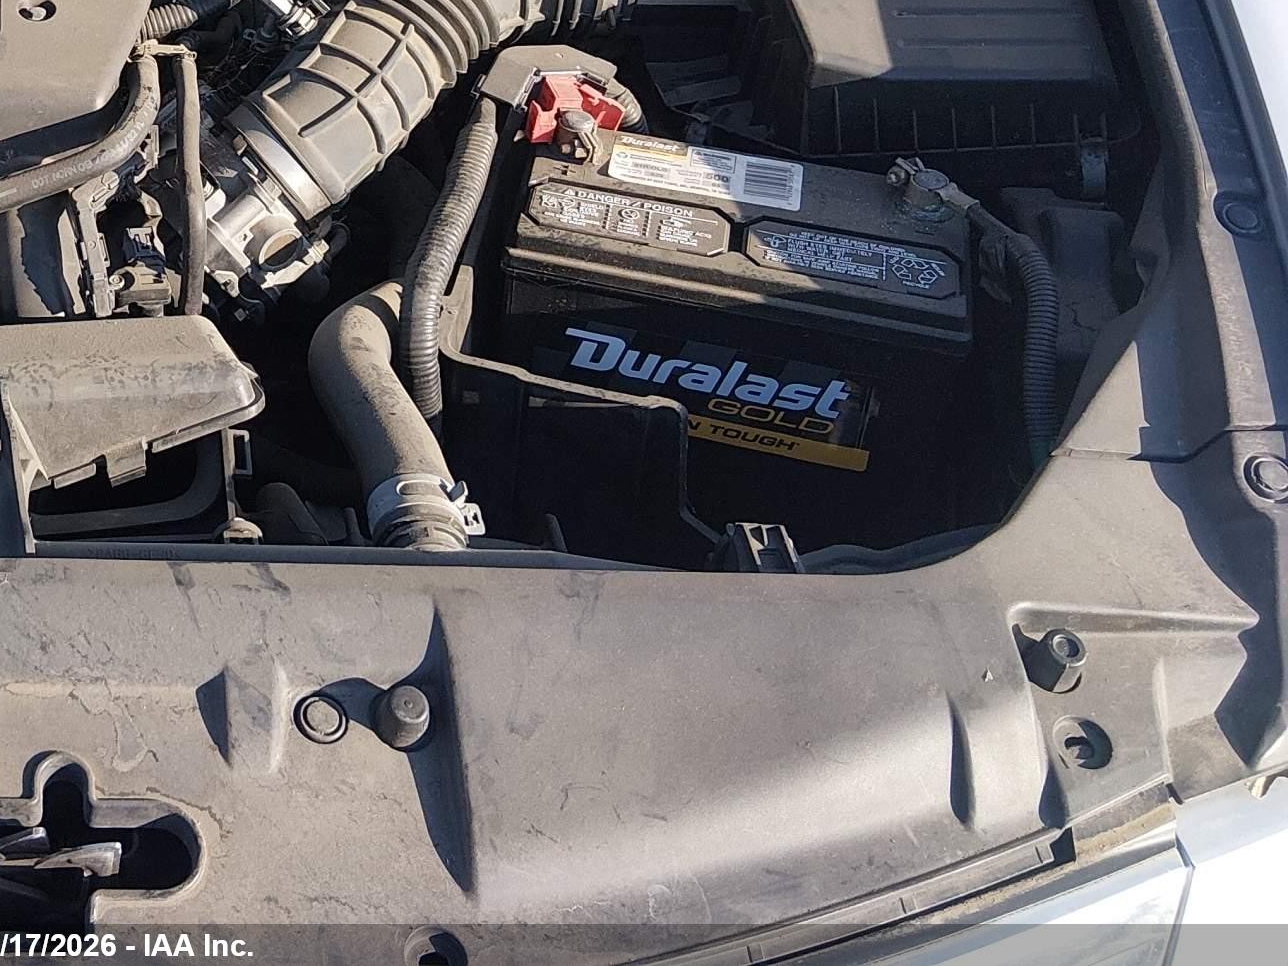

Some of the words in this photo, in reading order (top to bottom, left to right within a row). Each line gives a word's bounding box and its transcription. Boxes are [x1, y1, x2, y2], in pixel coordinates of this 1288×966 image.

[621, 135, 681, 152] Duralast
[578, 191, 632, 205] DANGER
[643, 202, 694, 217] POISON
[565, 327, 853, 419] Duralast
[708, 398, 835, 434] GOLD
[710, 425, 795, 451] TOUGH
